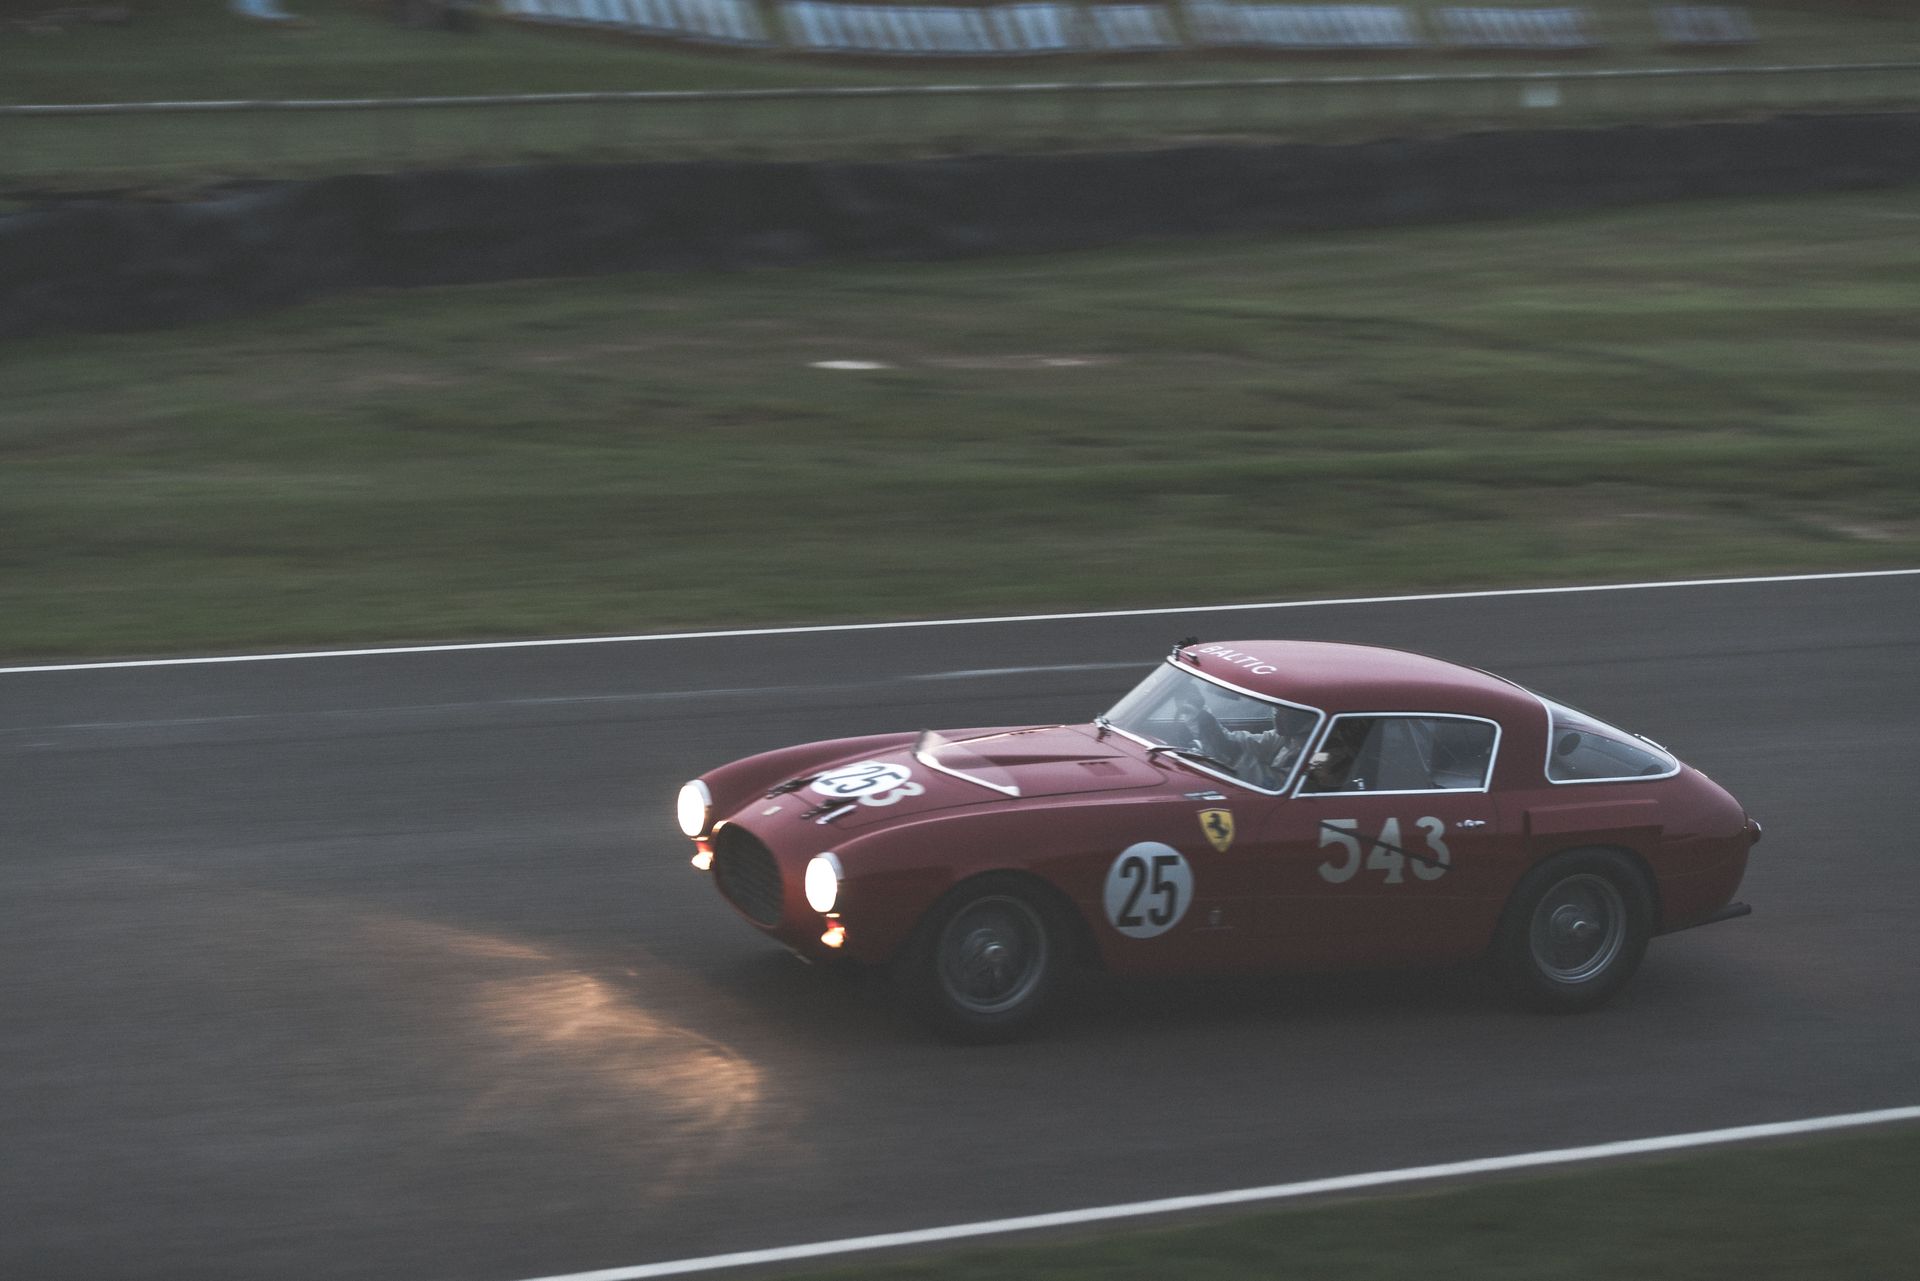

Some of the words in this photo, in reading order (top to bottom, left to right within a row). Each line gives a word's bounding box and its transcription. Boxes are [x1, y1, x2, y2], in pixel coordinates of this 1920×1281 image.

[1199, 645, 1278, 675] BALTIC
[819, 765, 903, 794] 25
[1318, 816, 1450, 884] 543
[1116, 855, 1181, 928] 25
